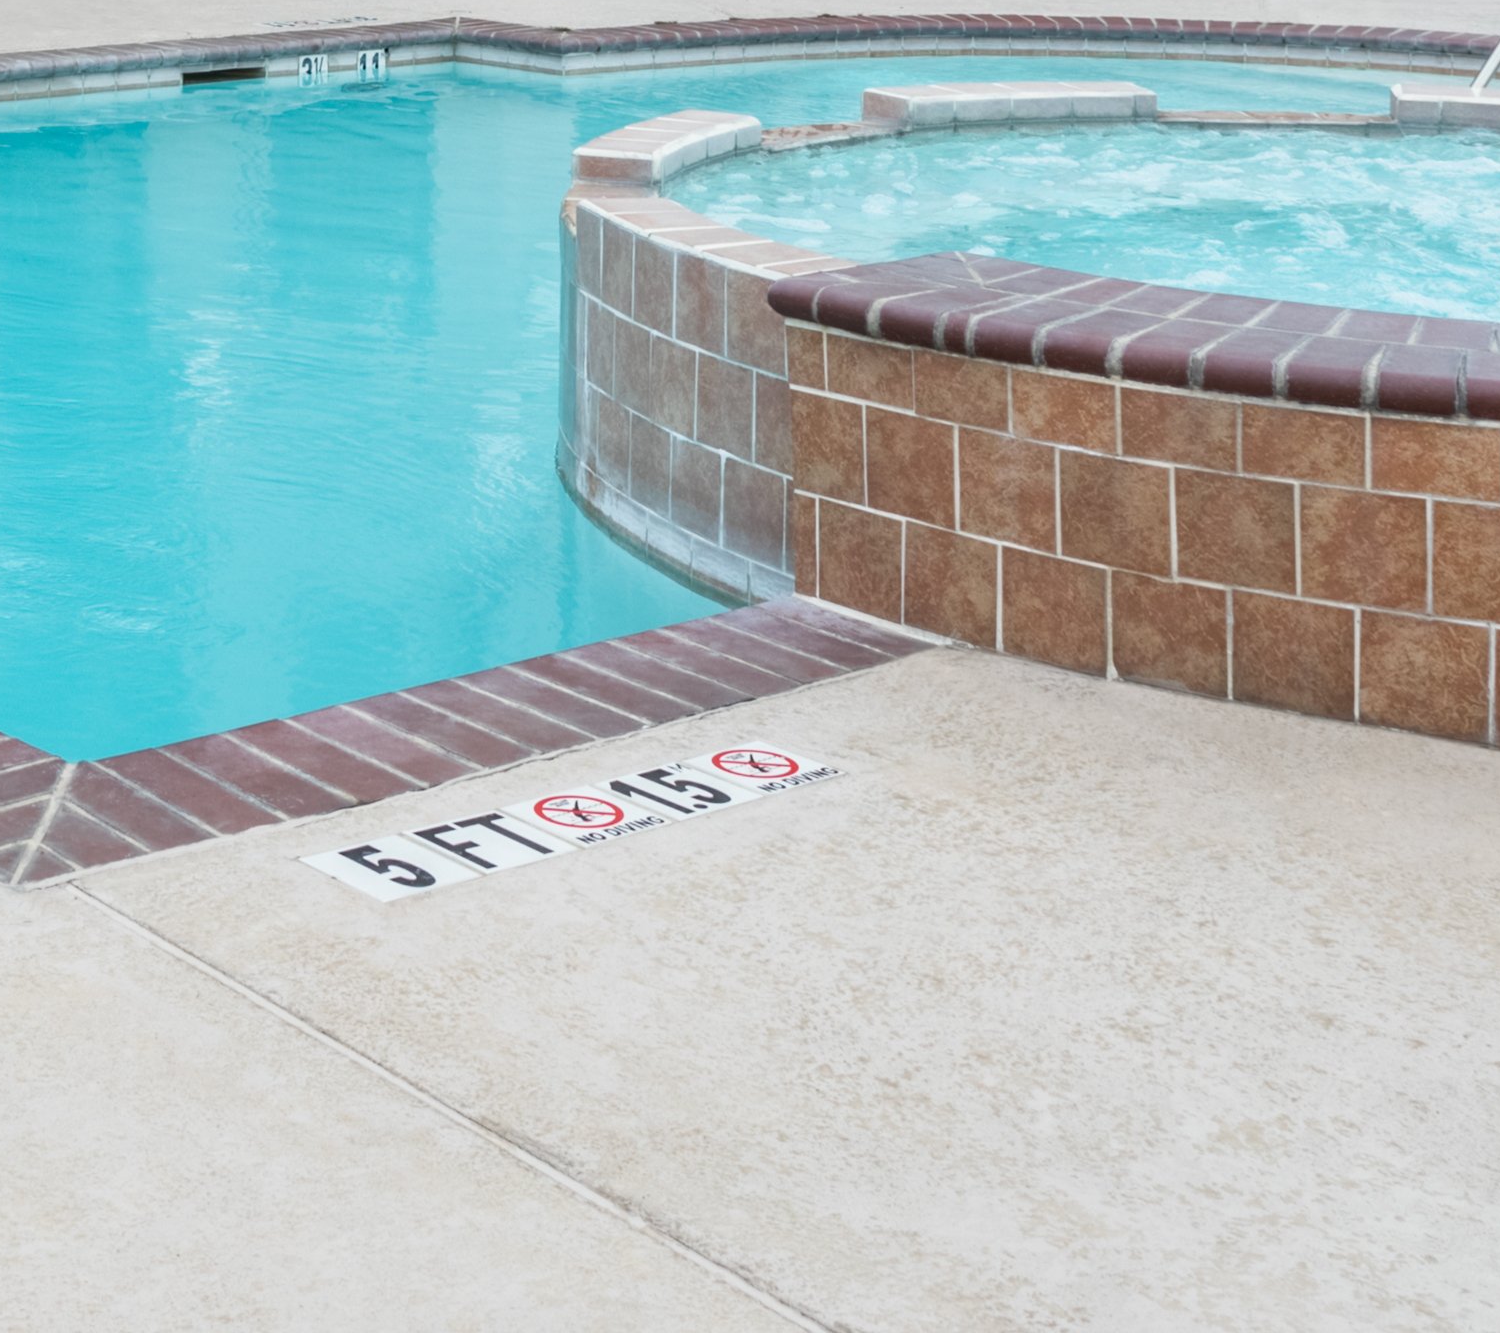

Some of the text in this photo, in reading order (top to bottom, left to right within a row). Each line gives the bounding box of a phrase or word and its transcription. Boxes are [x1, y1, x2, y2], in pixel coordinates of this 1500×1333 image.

[610, 769, 731, 814] 1.5
[757, 767, 838, 793] NO DIVING
[576, 815, 664, 844] NO DIVING
[338, 813, 554, 887] 5 FT
